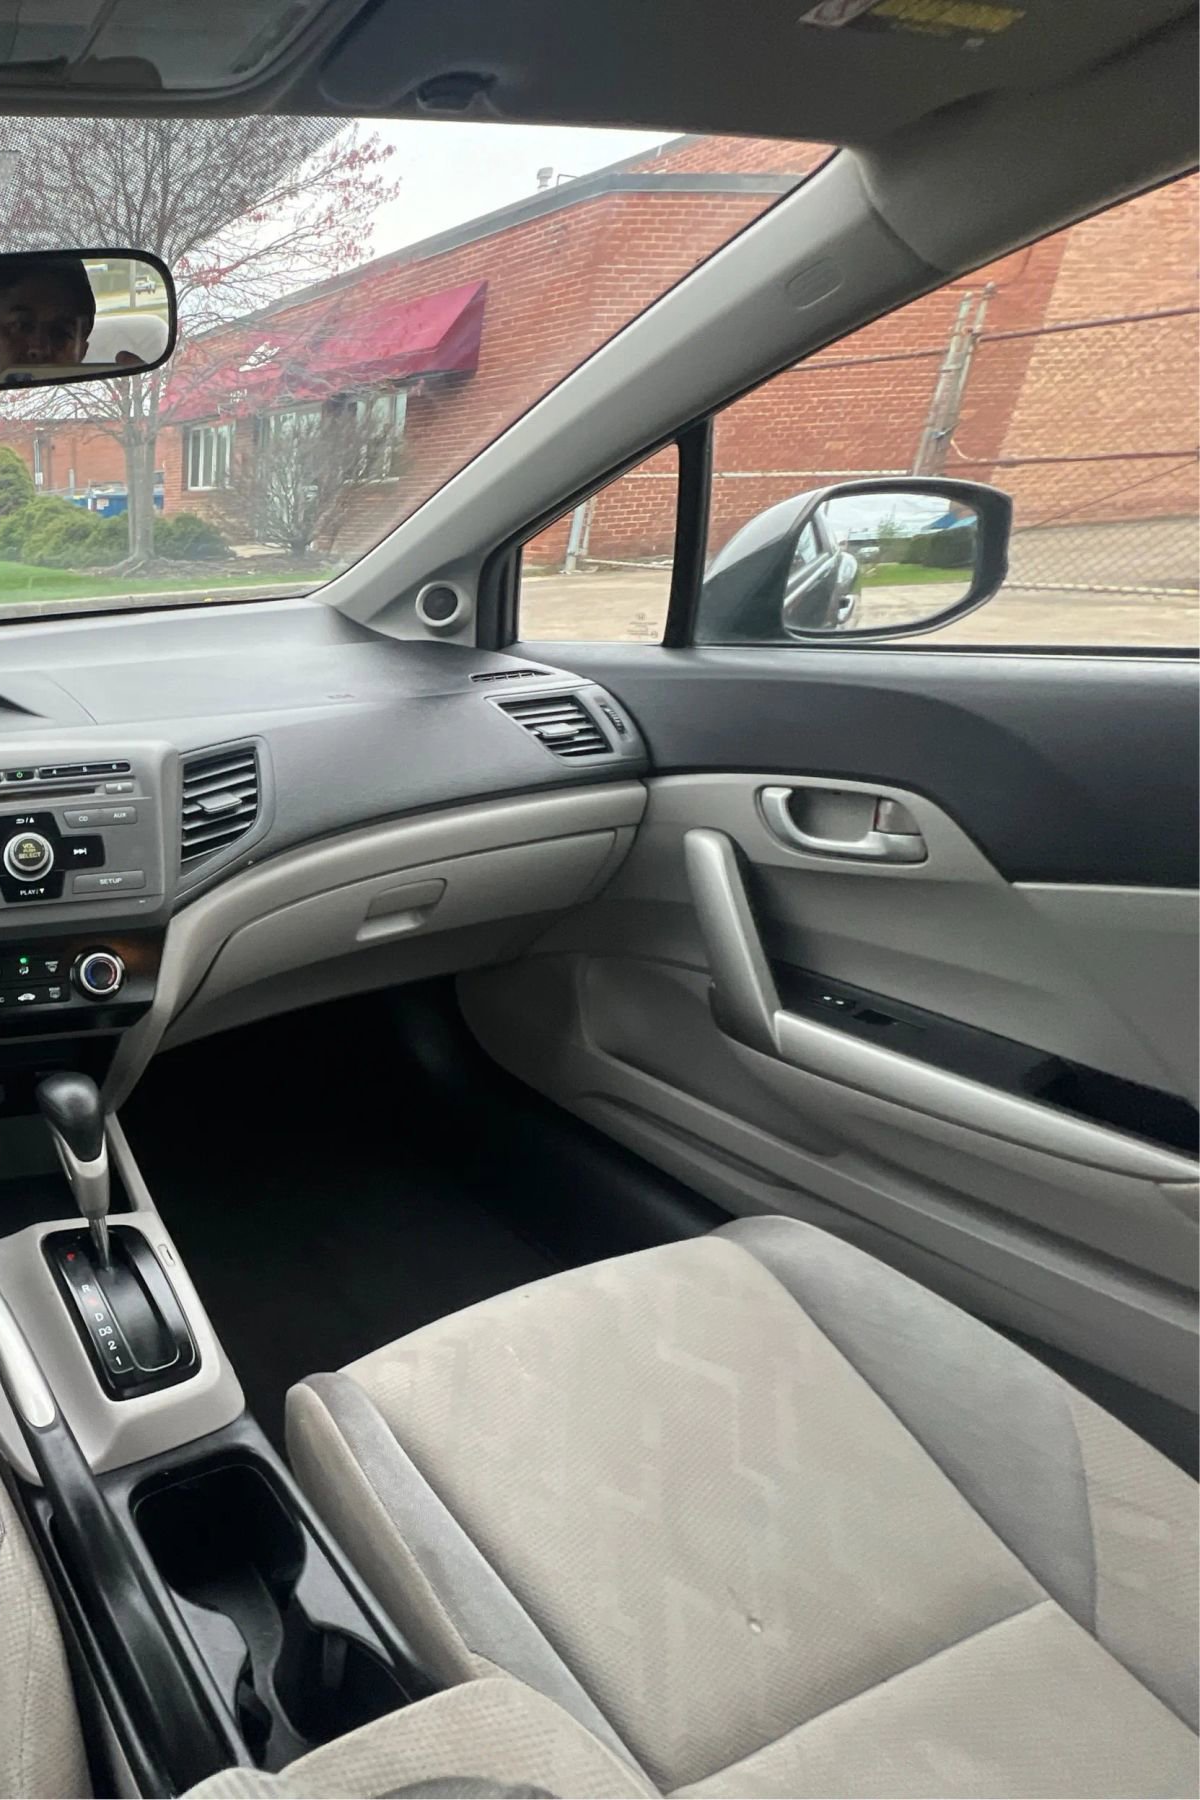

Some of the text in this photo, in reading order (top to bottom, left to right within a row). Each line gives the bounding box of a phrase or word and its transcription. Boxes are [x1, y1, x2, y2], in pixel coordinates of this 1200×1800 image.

[99, 877, 122, 885] SETUP
[81, 1284, 91, 1293] R
[94, 1312, 104, 1321] D
[98, 1326, 113, 1336] D3
[107, 1340, 117, 1350] 2
[115, 1356, 121, 1365] 1
